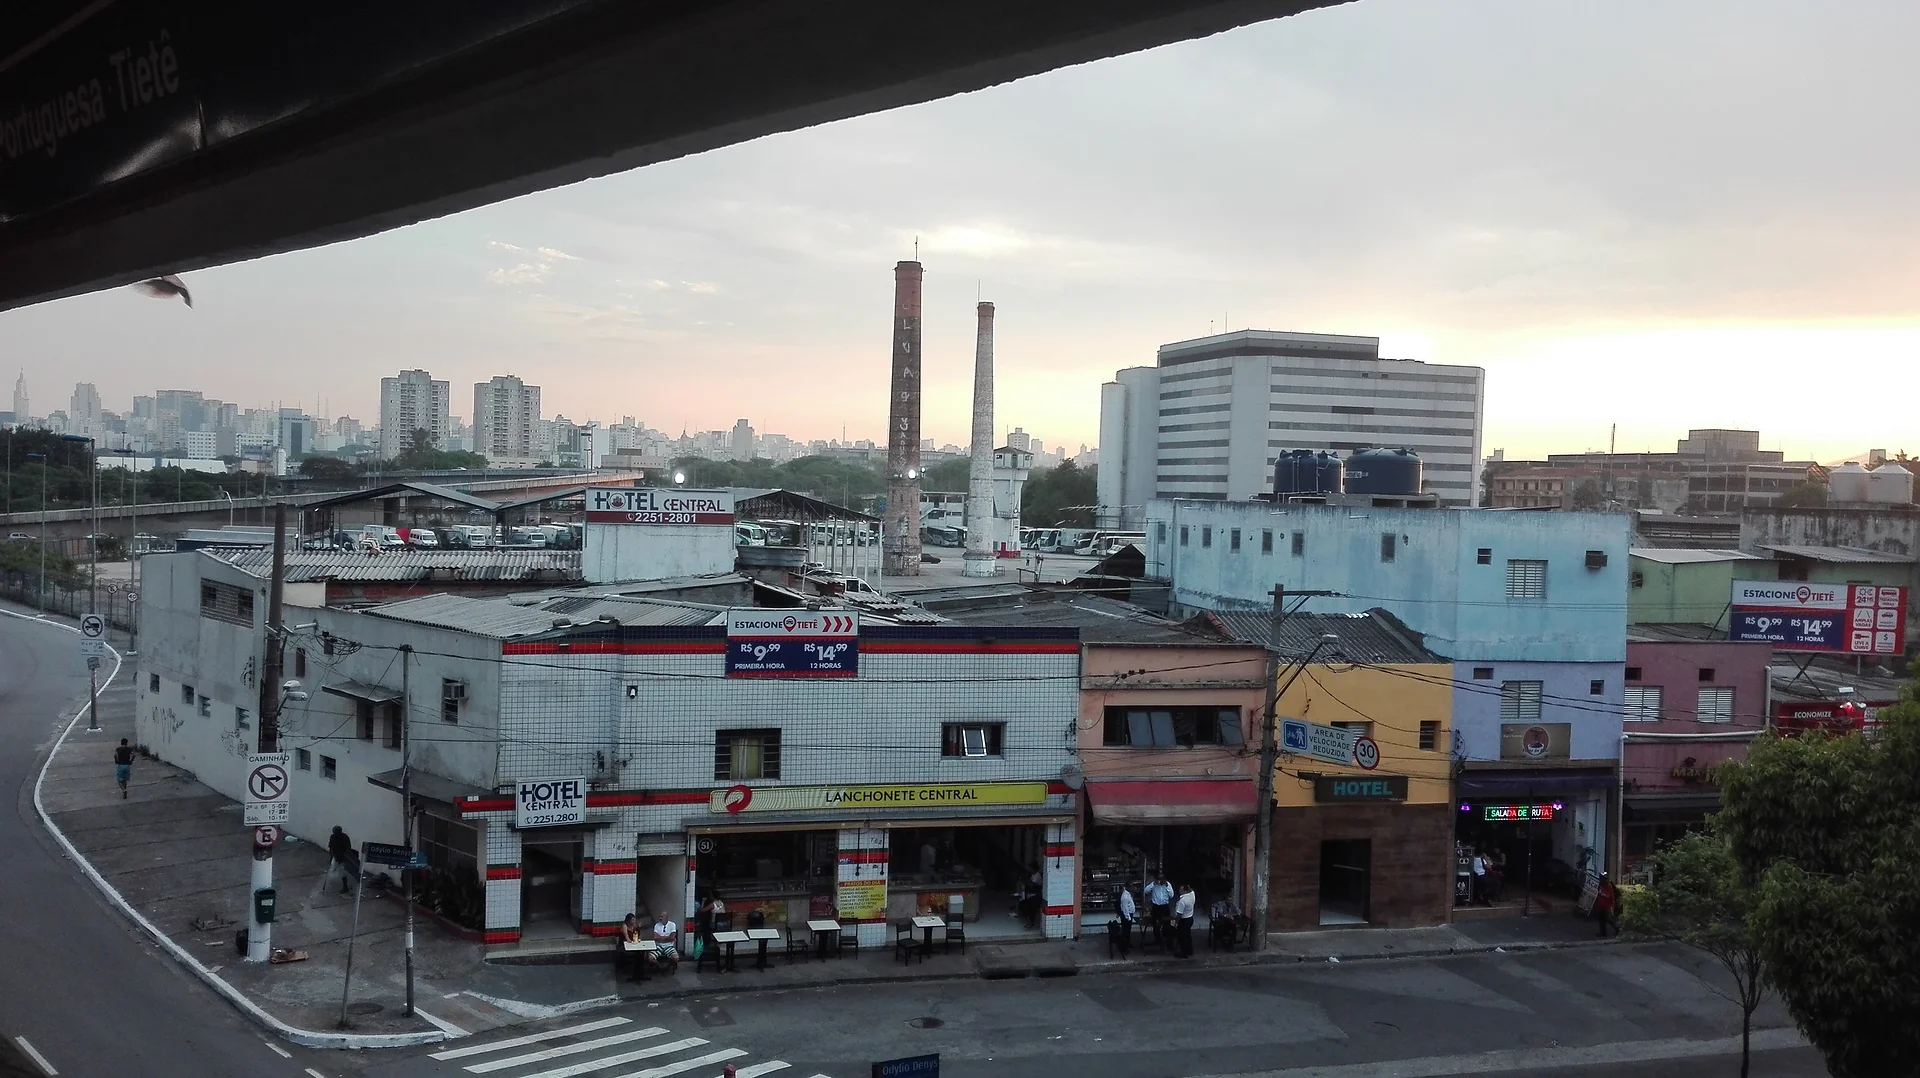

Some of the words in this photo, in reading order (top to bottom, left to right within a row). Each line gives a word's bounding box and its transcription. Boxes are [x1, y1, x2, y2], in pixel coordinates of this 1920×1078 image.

[109, 28, 179, 112] Tietê
[663, 498, 726, 512] CENTRAL
[634, 512, 698, 523] 2251-2801
[1743, 589, 1796, 600] ESTACIONE
[1811, 590, 1834, 602] TIETÊ
[734, 620, 783, 630] ESTACIONE
[796, 618, 818, 630] TIETÊ
[1745, 616, 1756, 625] R$
[1790, 618, 1801, 627] R$
[740, 643, 752, 653] R$
[804, 643, 816, 653] R$
[734, 662, 764, 670] PRIMEIRA
[765, 662, 786, 670] HORA
[809, 662, 818, 670] 12
[819, 662, 842, 670] HORAS
[1794, 711, 1832, 719] ECONOMIZE
[1336, 732, 1345, 741] DE
[1308, 735, 1351, 751] VELOCIDADE
[1313, 745, 1346, 758] REDUZIDA
[1359, 743, 1375, 759] 30
[520, 781, 583, 803] HOTEL
[1333, 781, 1393, 796] HOTEL
[825, 789, 916, 803] LANCHONETE
[919, 788, 978, 801] CENTRAL
[525, 800, 577, 812] CENTRAL
[533, 812, 579, 825] 2251.2801
[1491, 808, 1517, 818] SALADA
[1517, 808, 1527, 817] DE
[1529, 808, 1550, 817] RUTA
[701, 840, 711, 850] 51
[882, 1062, 910, 1077] Odylio
[911, 1059, 938, 1072] Denys
